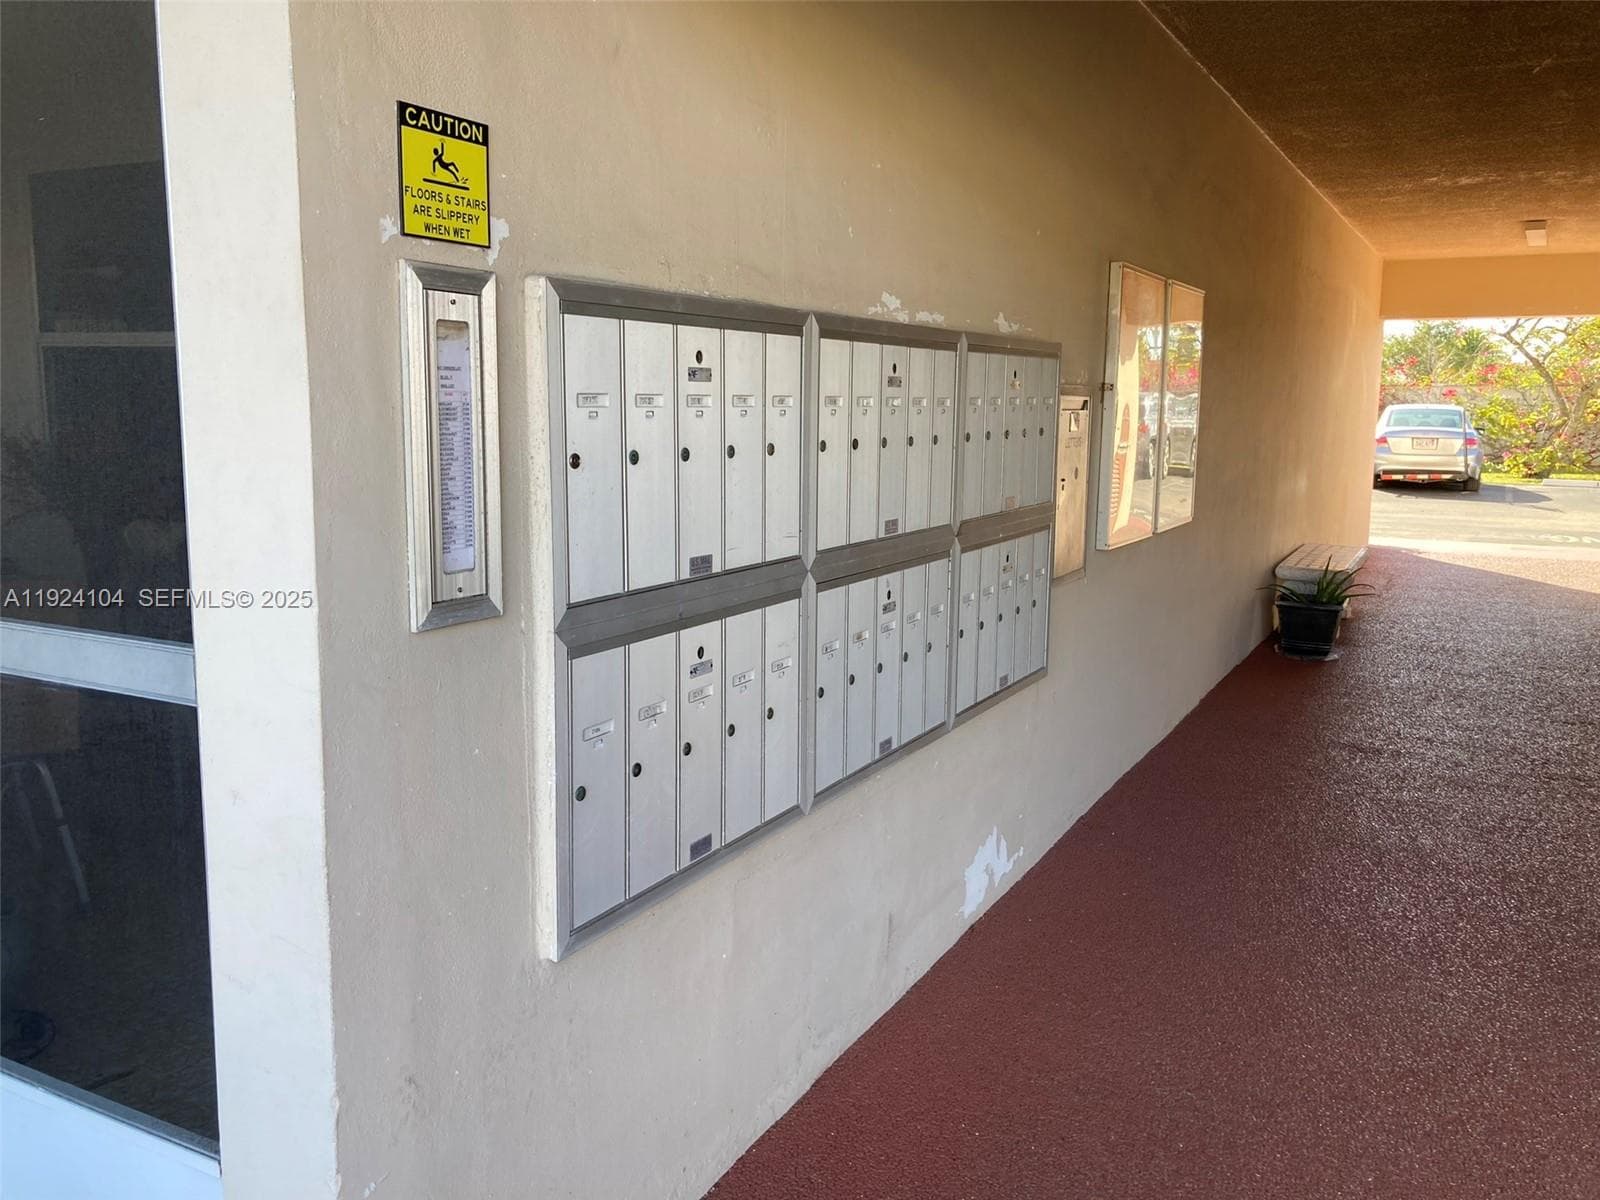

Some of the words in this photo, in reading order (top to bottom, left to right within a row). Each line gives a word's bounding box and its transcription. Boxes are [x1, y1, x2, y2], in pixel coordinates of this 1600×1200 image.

[405, 106, 483, 143] CAUTION
[404, 185, 443, 203] FLOORS
[445, 194, 451, 205] &
[454, 195, 487, 212] STAIRS
[413, 204, 432, 217] ARE
[435, 207, 480, 225] SLIPPERY
[424, 221, 450, 236] WHEN
[453, 227, 471, 240] WET
